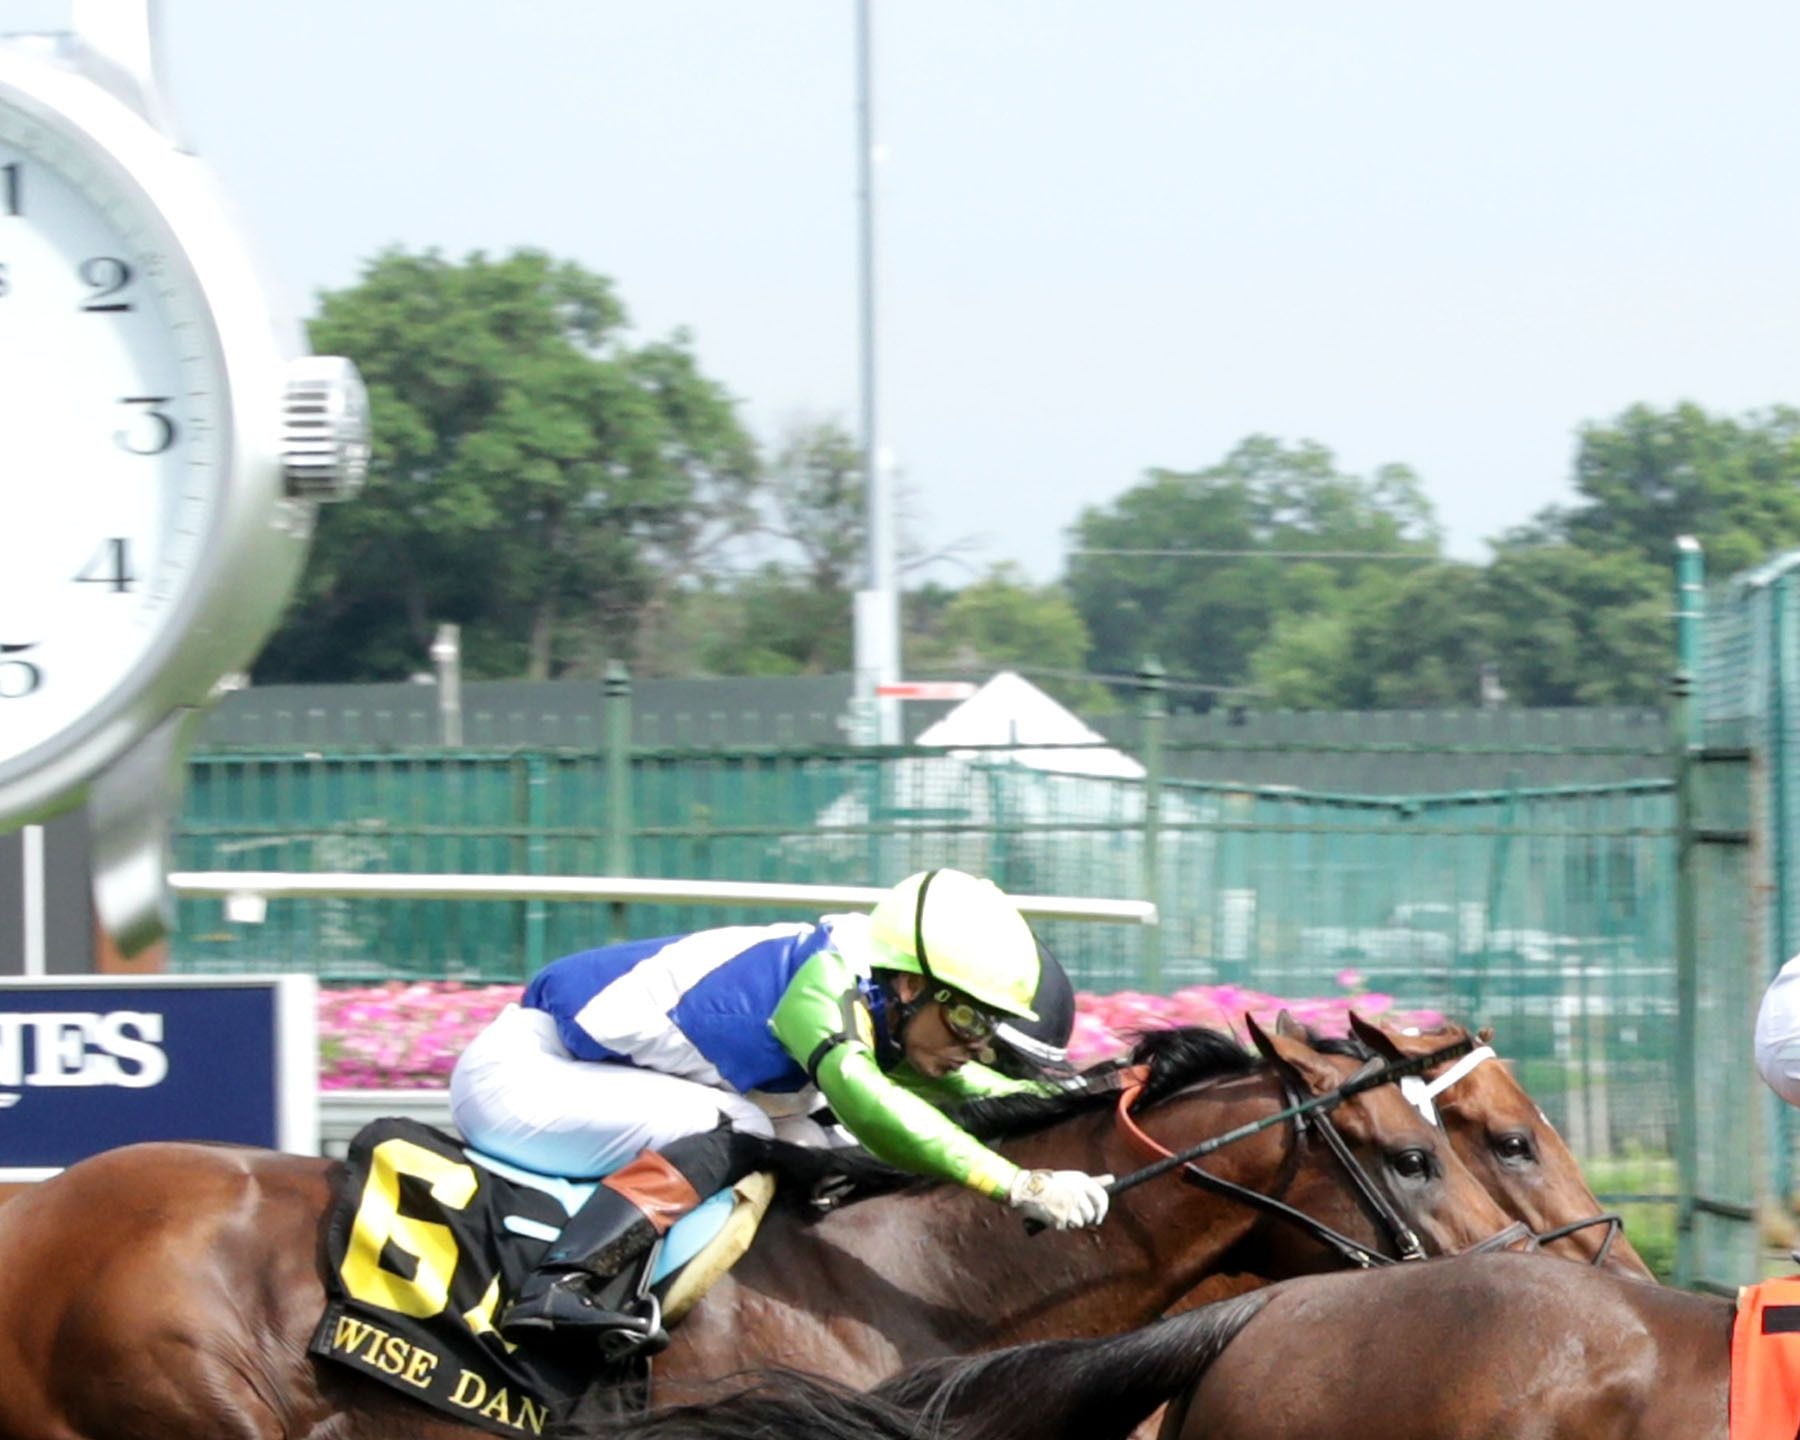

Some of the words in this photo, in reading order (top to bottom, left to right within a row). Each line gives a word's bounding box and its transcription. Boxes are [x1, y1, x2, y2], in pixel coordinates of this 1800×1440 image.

[79, 256, 132, 311] 2
[112, 396, 177, 455] 3
[70, 537, 140, 593] 4
[340, 1138, 478, 1319] 6
[332, 1315, 440, 1389] WISE
[448, 1369, 549, 1435] DAN
